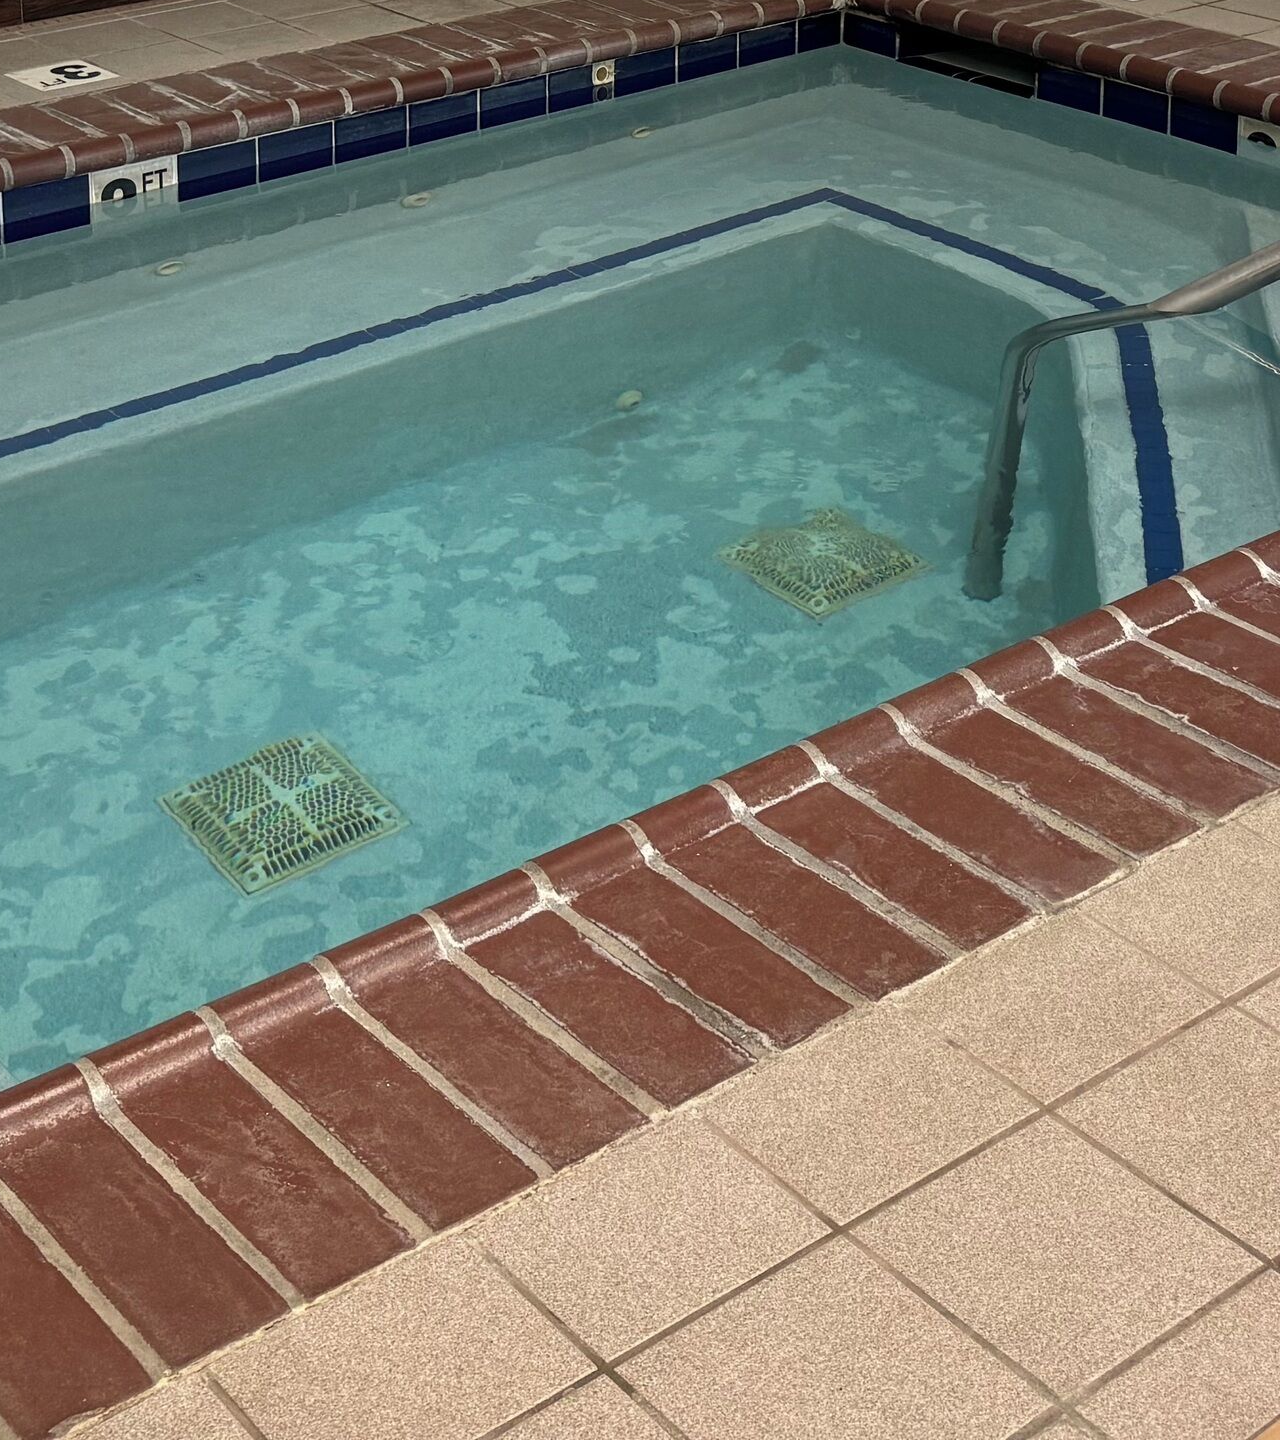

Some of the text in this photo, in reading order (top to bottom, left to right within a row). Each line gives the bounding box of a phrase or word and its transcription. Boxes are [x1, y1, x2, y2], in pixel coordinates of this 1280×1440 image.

[39, 64, 102, 88] 3 FT
[142, 167, 168, 193] FT
